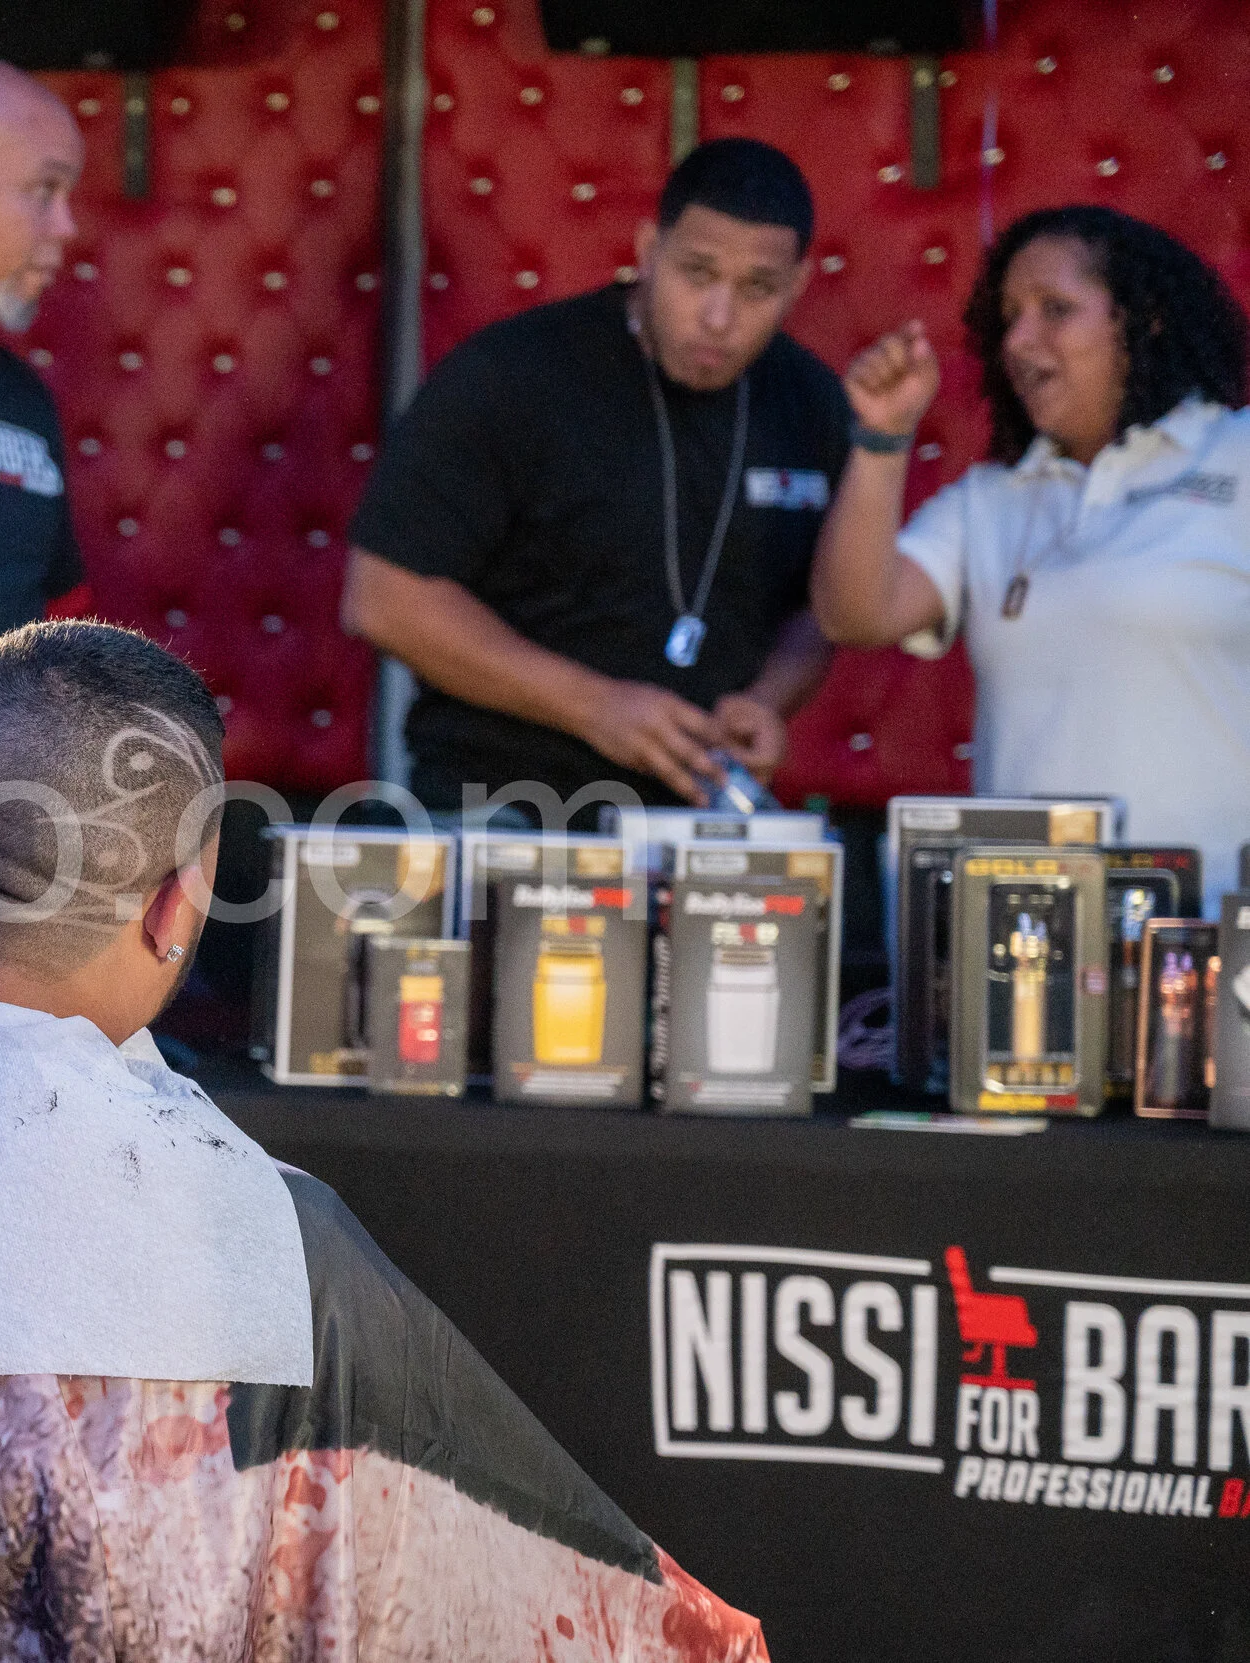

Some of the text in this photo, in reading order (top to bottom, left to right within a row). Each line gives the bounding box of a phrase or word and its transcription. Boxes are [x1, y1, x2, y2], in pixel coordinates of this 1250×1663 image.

[667, 1269, 938, 1447] NISSI
[955, 1383, 1041, 1458] FOR
[953, 1454, 1250, 1519] PROFESSIONAL B
